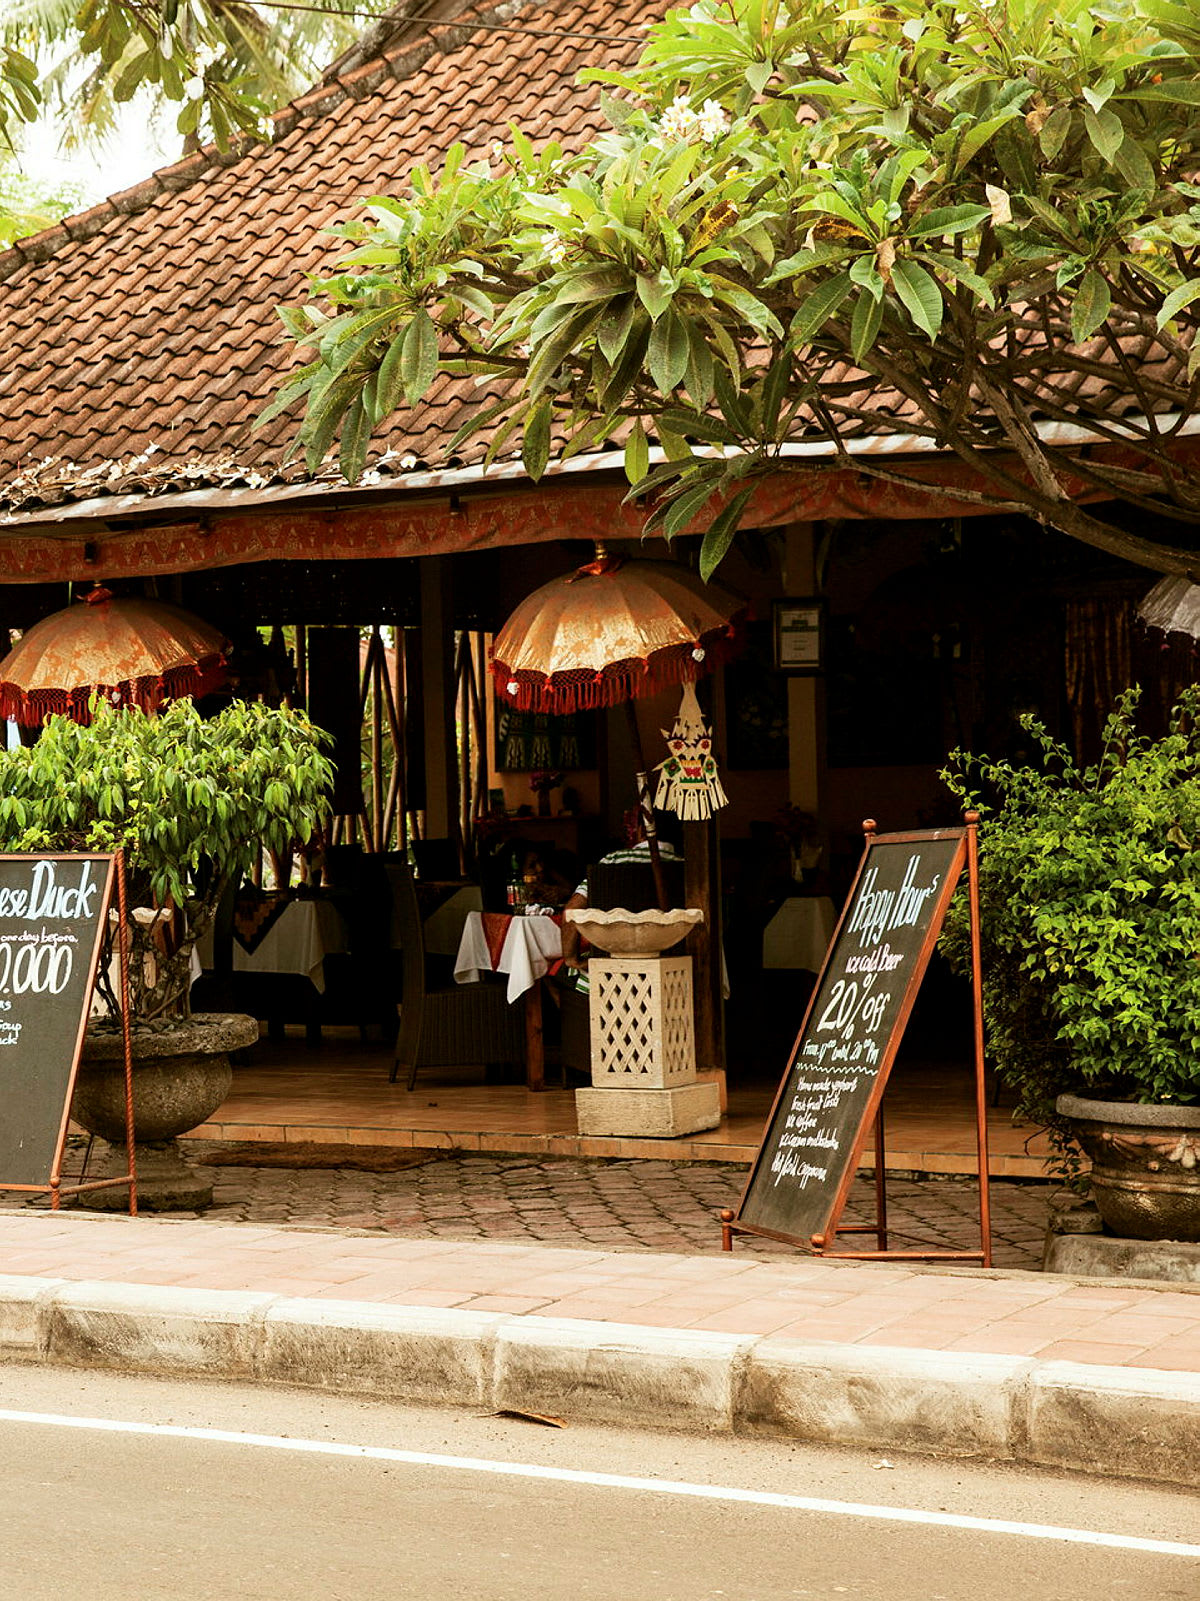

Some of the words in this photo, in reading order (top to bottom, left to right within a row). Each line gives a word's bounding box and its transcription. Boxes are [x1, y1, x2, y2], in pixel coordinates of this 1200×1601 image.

[22, 860, 97, 920] Duck
[848, 867, 896, 948] Happy
[887, 855, 941, 932] Hours
[0, 934, 18, 943] one
[17, 930, 40, 946] day
[877, 943, 905, 972] Beer
[861, 993, 890, 1033] off
